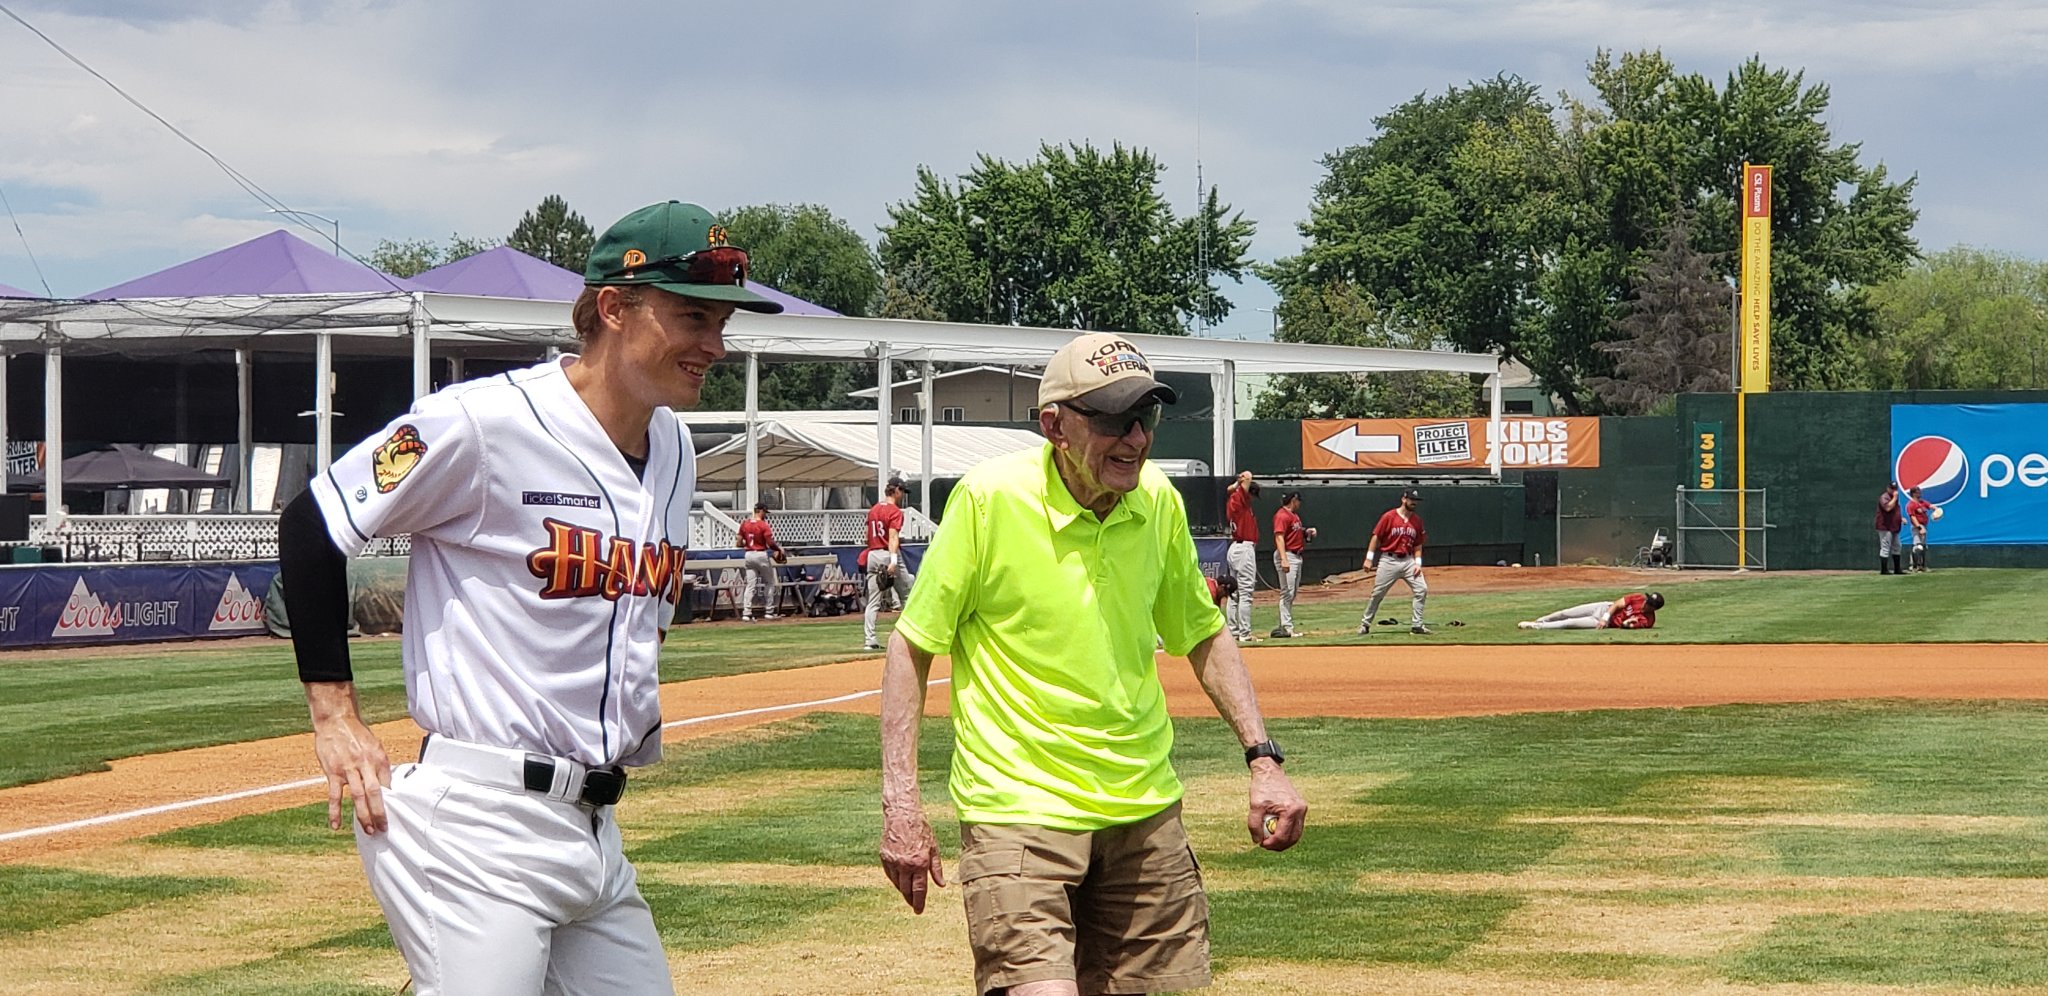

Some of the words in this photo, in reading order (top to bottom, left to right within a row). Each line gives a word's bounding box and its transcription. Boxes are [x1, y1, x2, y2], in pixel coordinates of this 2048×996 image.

[1754, 173, 1763, 187] CSL
[1753, 187, 1762, 213] Plasma
[1754, 222, 1761, 235] DO
[1753, 256, 1761, 296] AMAZING
[1416, 427, 1465, 440] PROJECT
[1486, 421, 1568, 442] KIDS
[6, 441, 36, 456] ROJECT
[1418, 439, 1467, 454] FILTER
[6, 457, 37, 475] ILTER
[1699, 433, 1715, 489] 335
[1980, 453, 2048, 498] pe
[523, 492, 599, 508] TicketSmarter
[871, 520, 885, 537] 13
[59, 593, 124, 629] Coors
[124, 601, 179, 627] LIGHT
